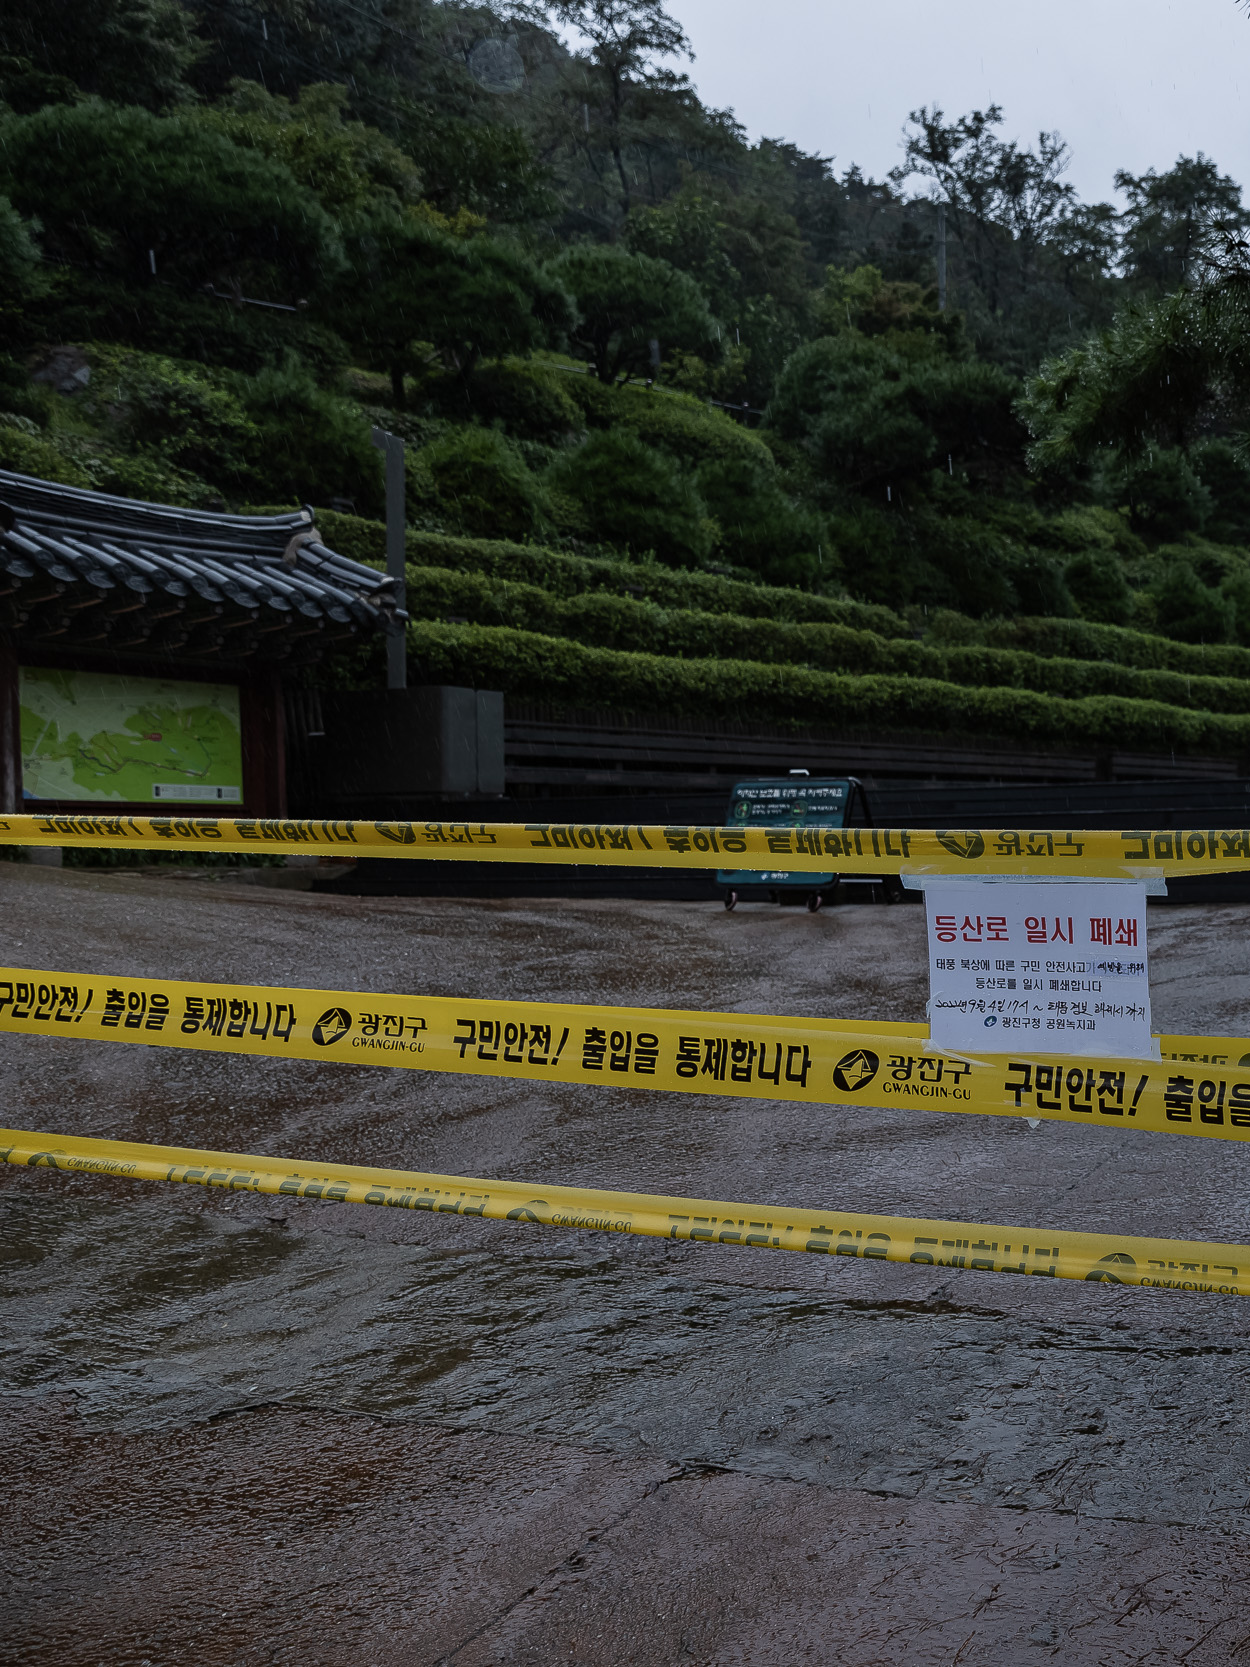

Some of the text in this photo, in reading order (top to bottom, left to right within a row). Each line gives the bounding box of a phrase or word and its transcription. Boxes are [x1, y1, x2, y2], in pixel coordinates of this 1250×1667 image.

[934, 915, 1139, 947] 등산로 일시 폐쇄
[936, 958, 956, 971] 태풍
[960, 959, 990, 972] 북상에
[995, 959, 1015, 972] 따른
[1020, 960, 1040, 973] 구민
[975, 978, 1103, 993] 등산로를 일시 폐쇄합니다
[0, 981, 297, 1042] 구민안전! 출입을 통제합니다
[1001, 1017, 1096, 1031] 광진구청 공원녹지과
[357, 1012, 428, 1039] 광진구
[352, 1037, 426, 1053] GWANGJIN-GU
[453, 1018, 812, 1088] 구민안전! 출입을 통제합니다
[886, 1054, 972, 1084] 광진구
[882, 1081, 972, 1100] GWANGJIN-GU
[1004, 1062, 1150, 1117] 구민안전!
